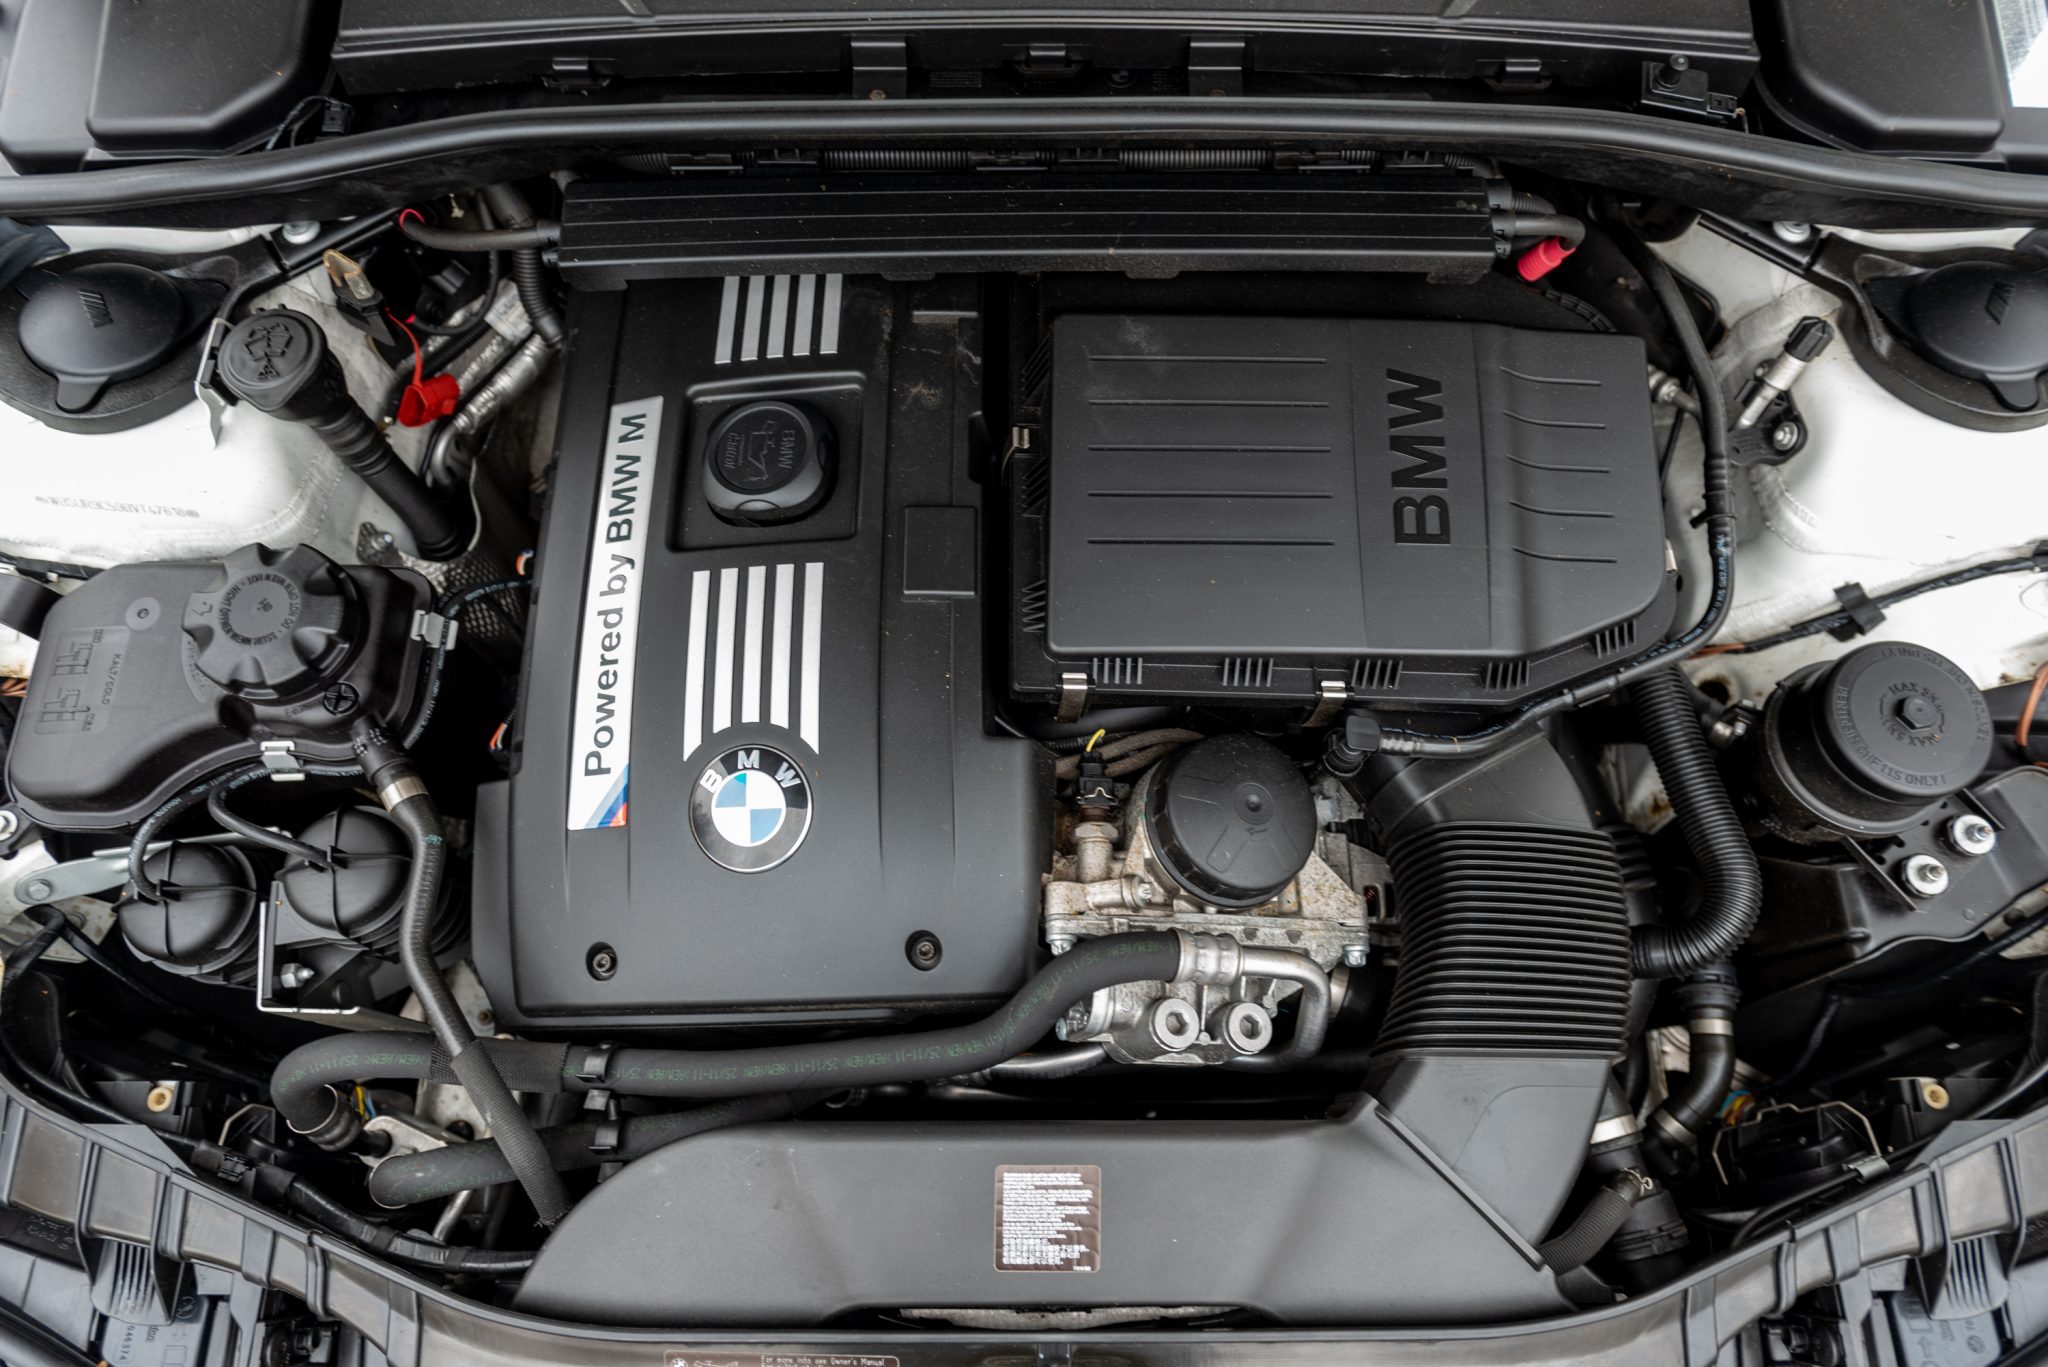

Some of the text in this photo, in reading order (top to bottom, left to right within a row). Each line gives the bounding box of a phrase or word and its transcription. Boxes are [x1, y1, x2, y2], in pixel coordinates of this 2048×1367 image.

[724, 432, 740, 469] Castrol
[778, 429, 796, 468] BMW
[1386, 367, 1452, 546] BMW
[584, 412, 647, 777] Powered by BMW M
[101, 653, 122, 705] KALT/COLD
[698, 748, 803, 795] BMW
[860, 1357, 885, 1367] Manual
